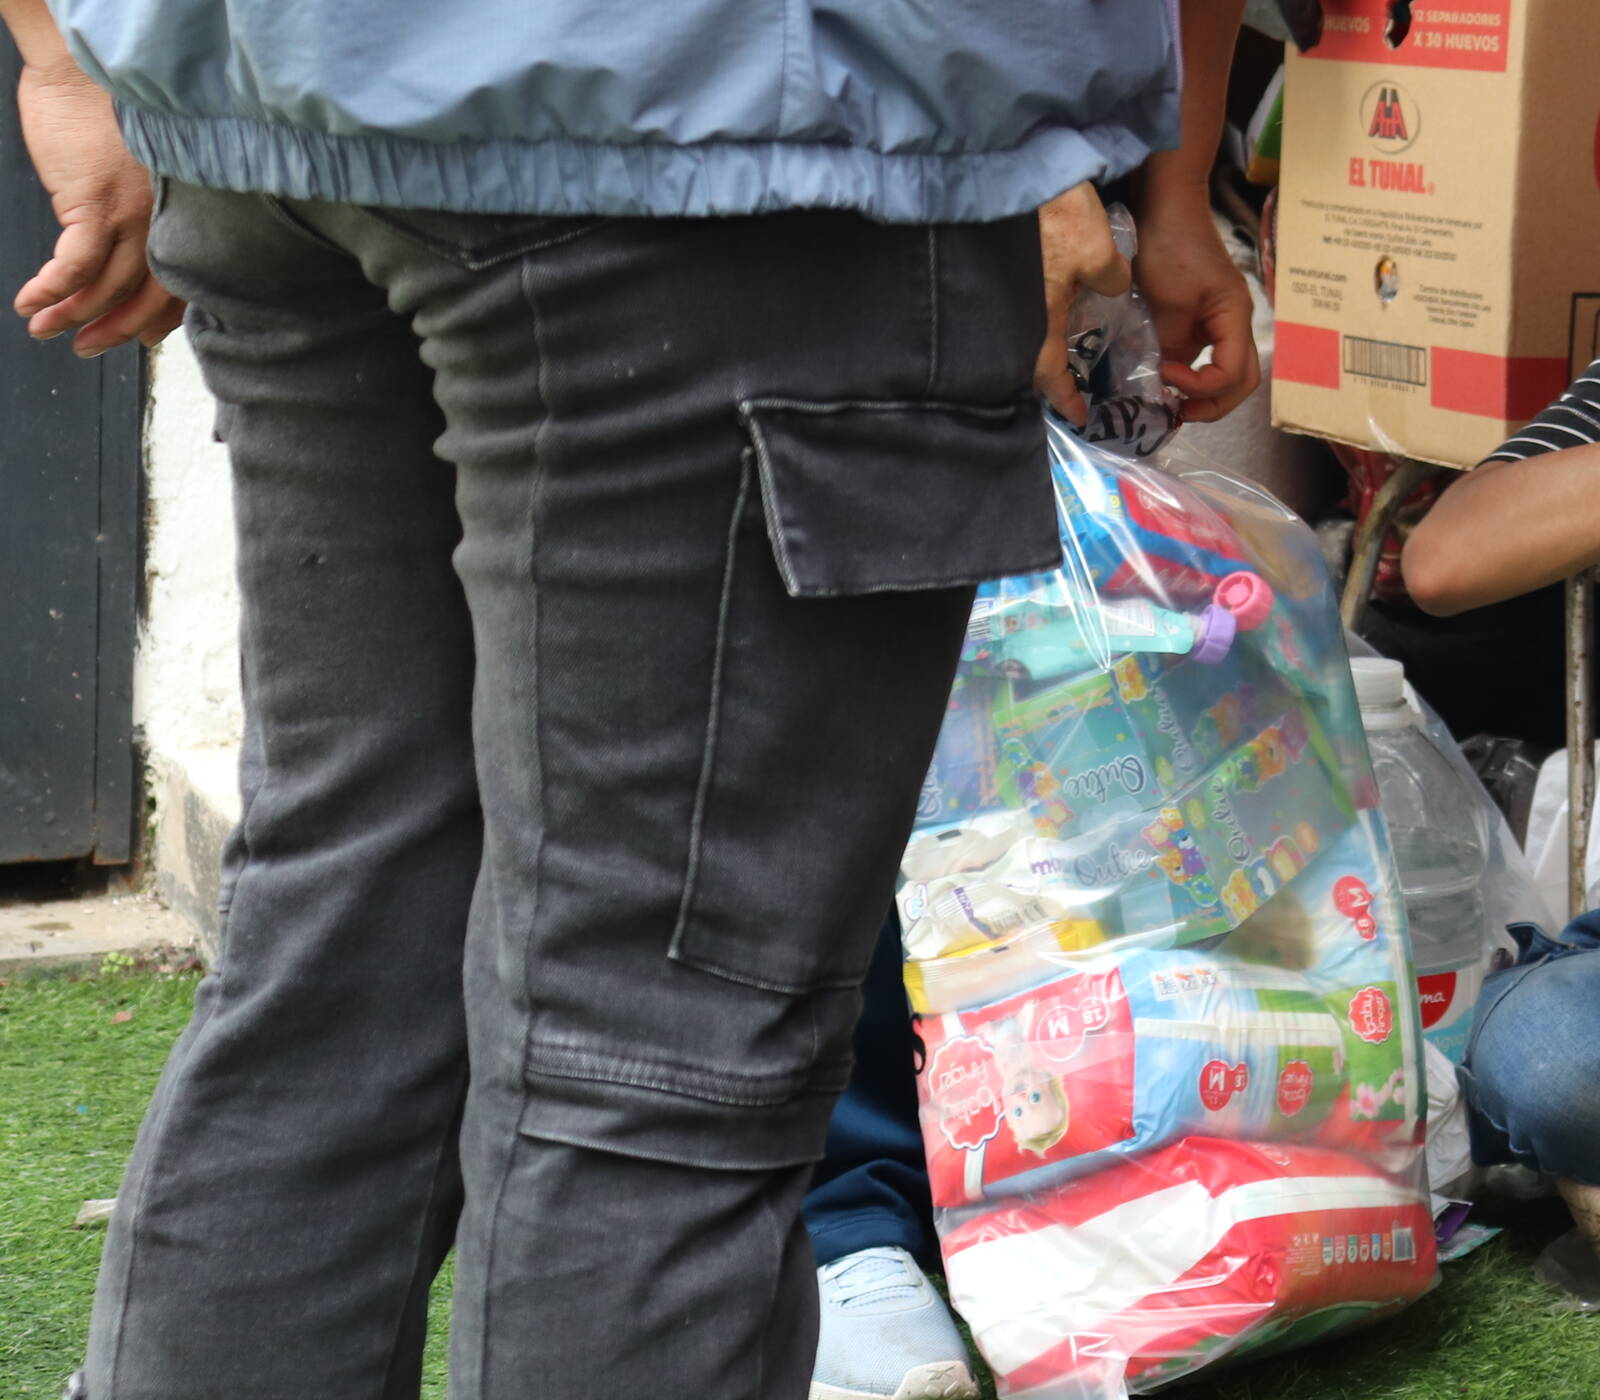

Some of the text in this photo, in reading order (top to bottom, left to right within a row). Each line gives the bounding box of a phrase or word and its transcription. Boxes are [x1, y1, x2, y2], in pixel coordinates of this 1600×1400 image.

[1426, 10, 1501, 27] SEPARADORES
[1425, 31, 1442, 48] 30
[1446, 32, 1499, 52] HUEVOS
[1348, 157, 1426, 194] EL TUNAL
[1359, 994, 1378, 1036] baby
